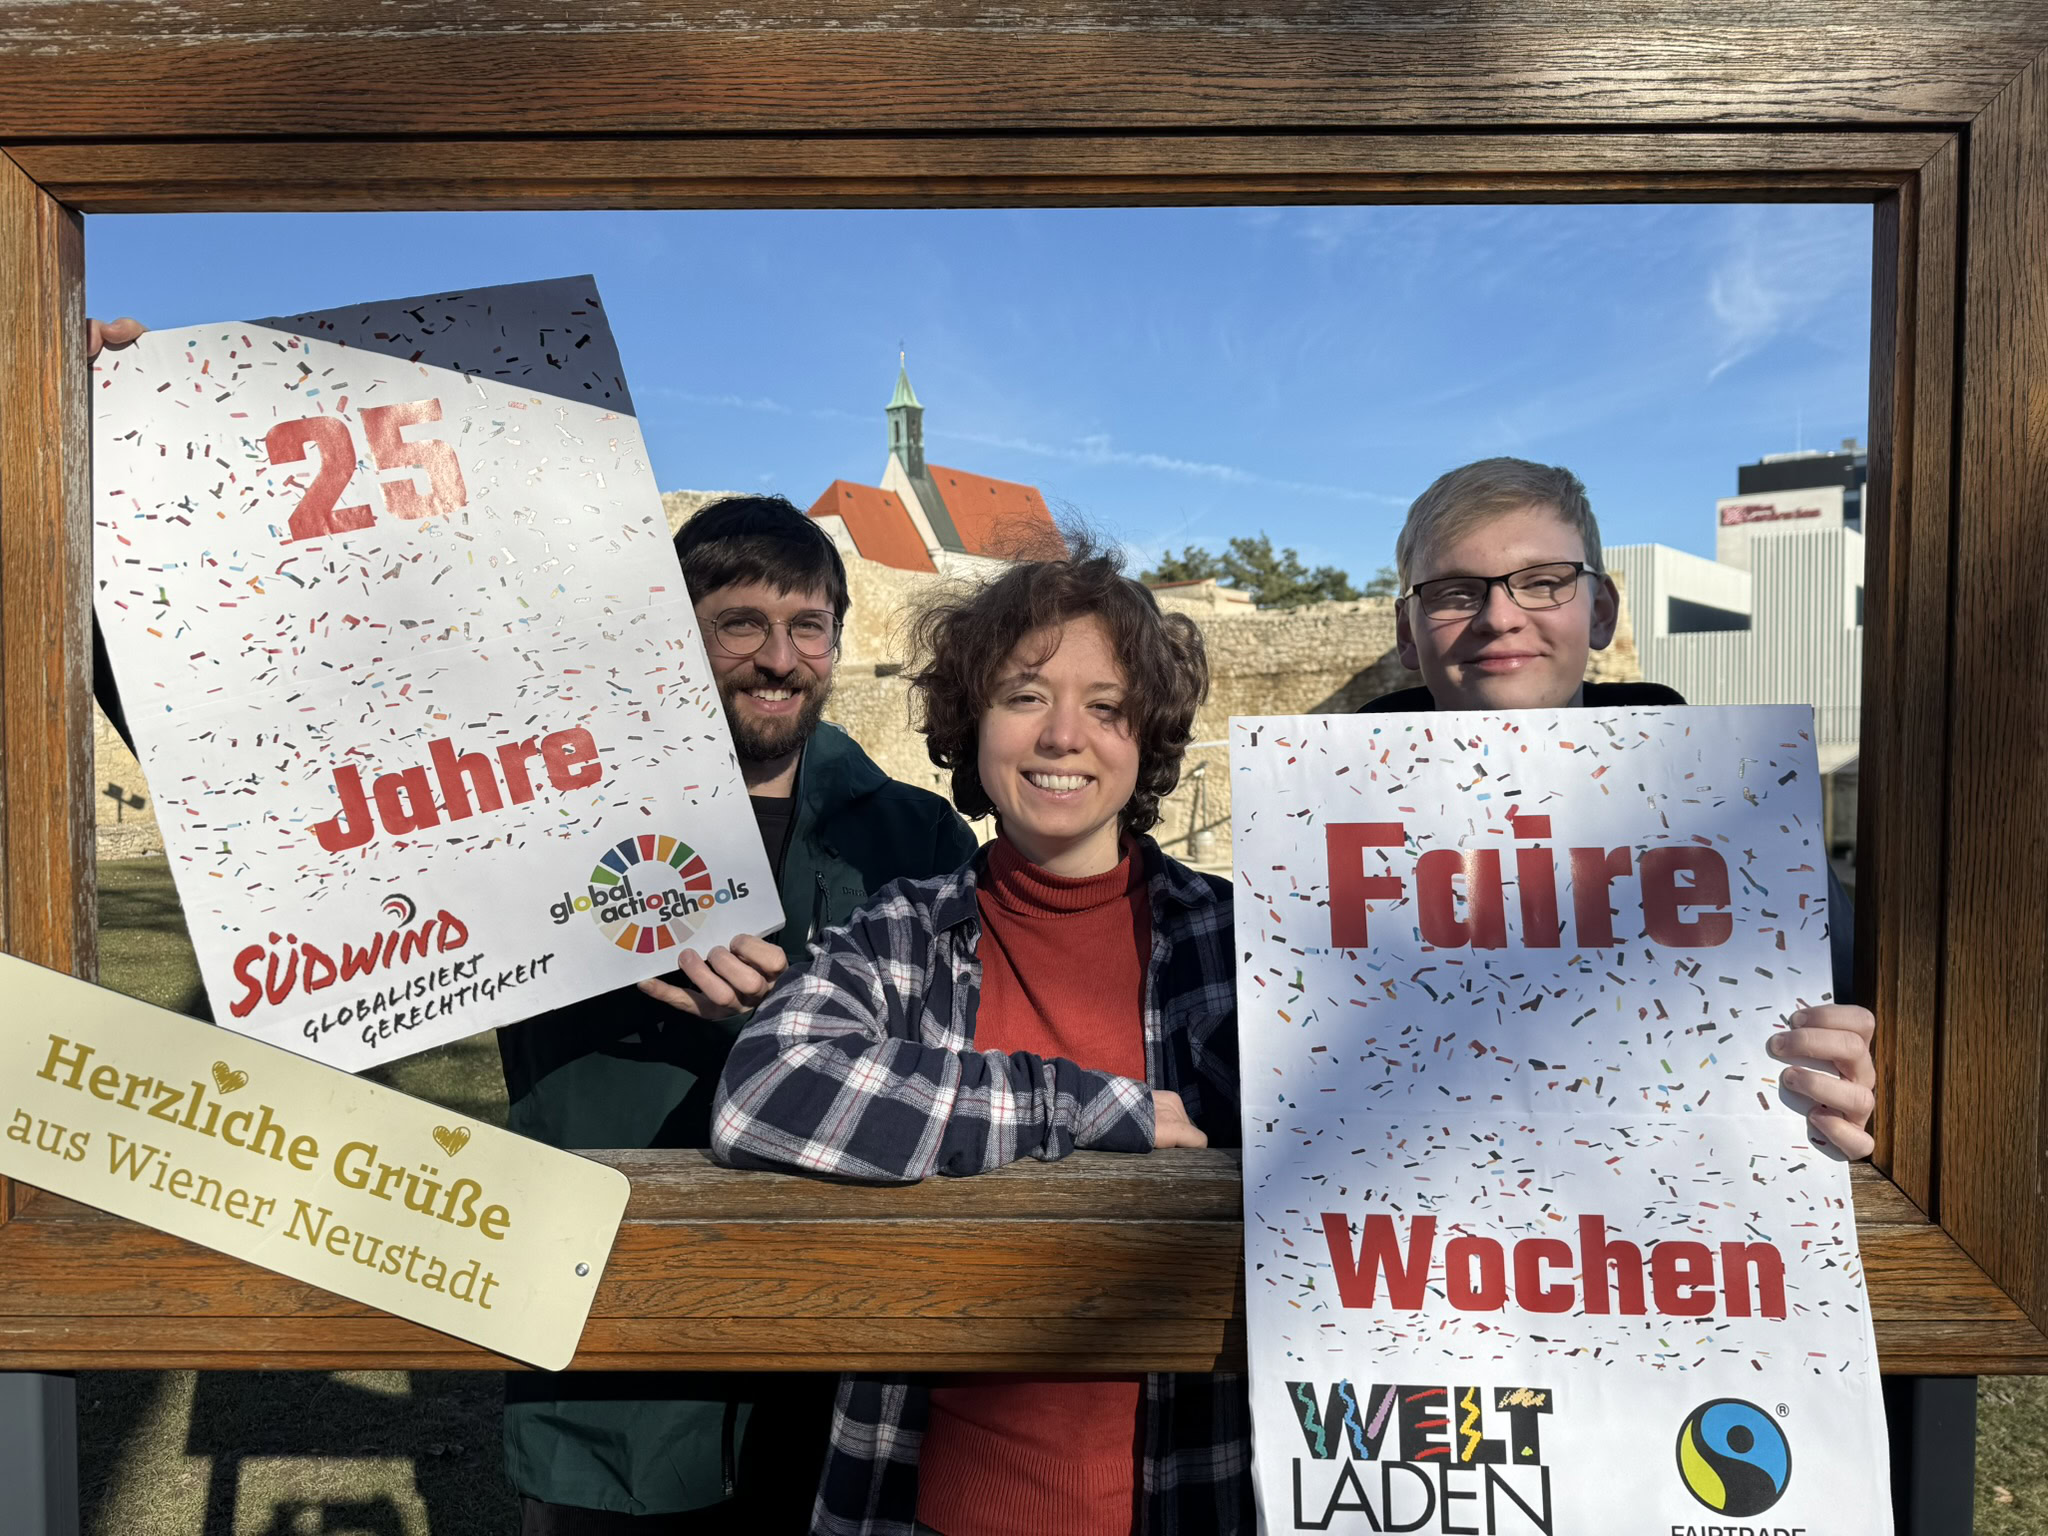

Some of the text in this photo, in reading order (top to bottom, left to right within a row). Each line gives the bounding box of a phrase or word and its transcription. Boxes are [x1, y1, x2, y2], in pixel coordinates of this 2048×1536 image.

[265, 398, 467, 541] 25
[313, 727, 602, 853] Jahre
[550, 875, 633, 925] global
[601, 888, 680, 924] action
[659, 878, 749, 922] schools
[1325, 814, 1733, 949] Faire
[229, 906, 469, 1018] SÜDWIND
[303, 953, 485, 1042] GLOBALISIERT
[361, 953, 555, 1047] GERECHTIGKEIT
[36, 1034, 511, 1240] Herzliche Grüße
[6, 1107, 500, 1310] aus Wiener Neustadt
[1320, 1212, 1788, 1318] Wochen
[1284, 1379, 1554, 1466] WELT
[1292, 1457, 1554, 1536] LADEN
